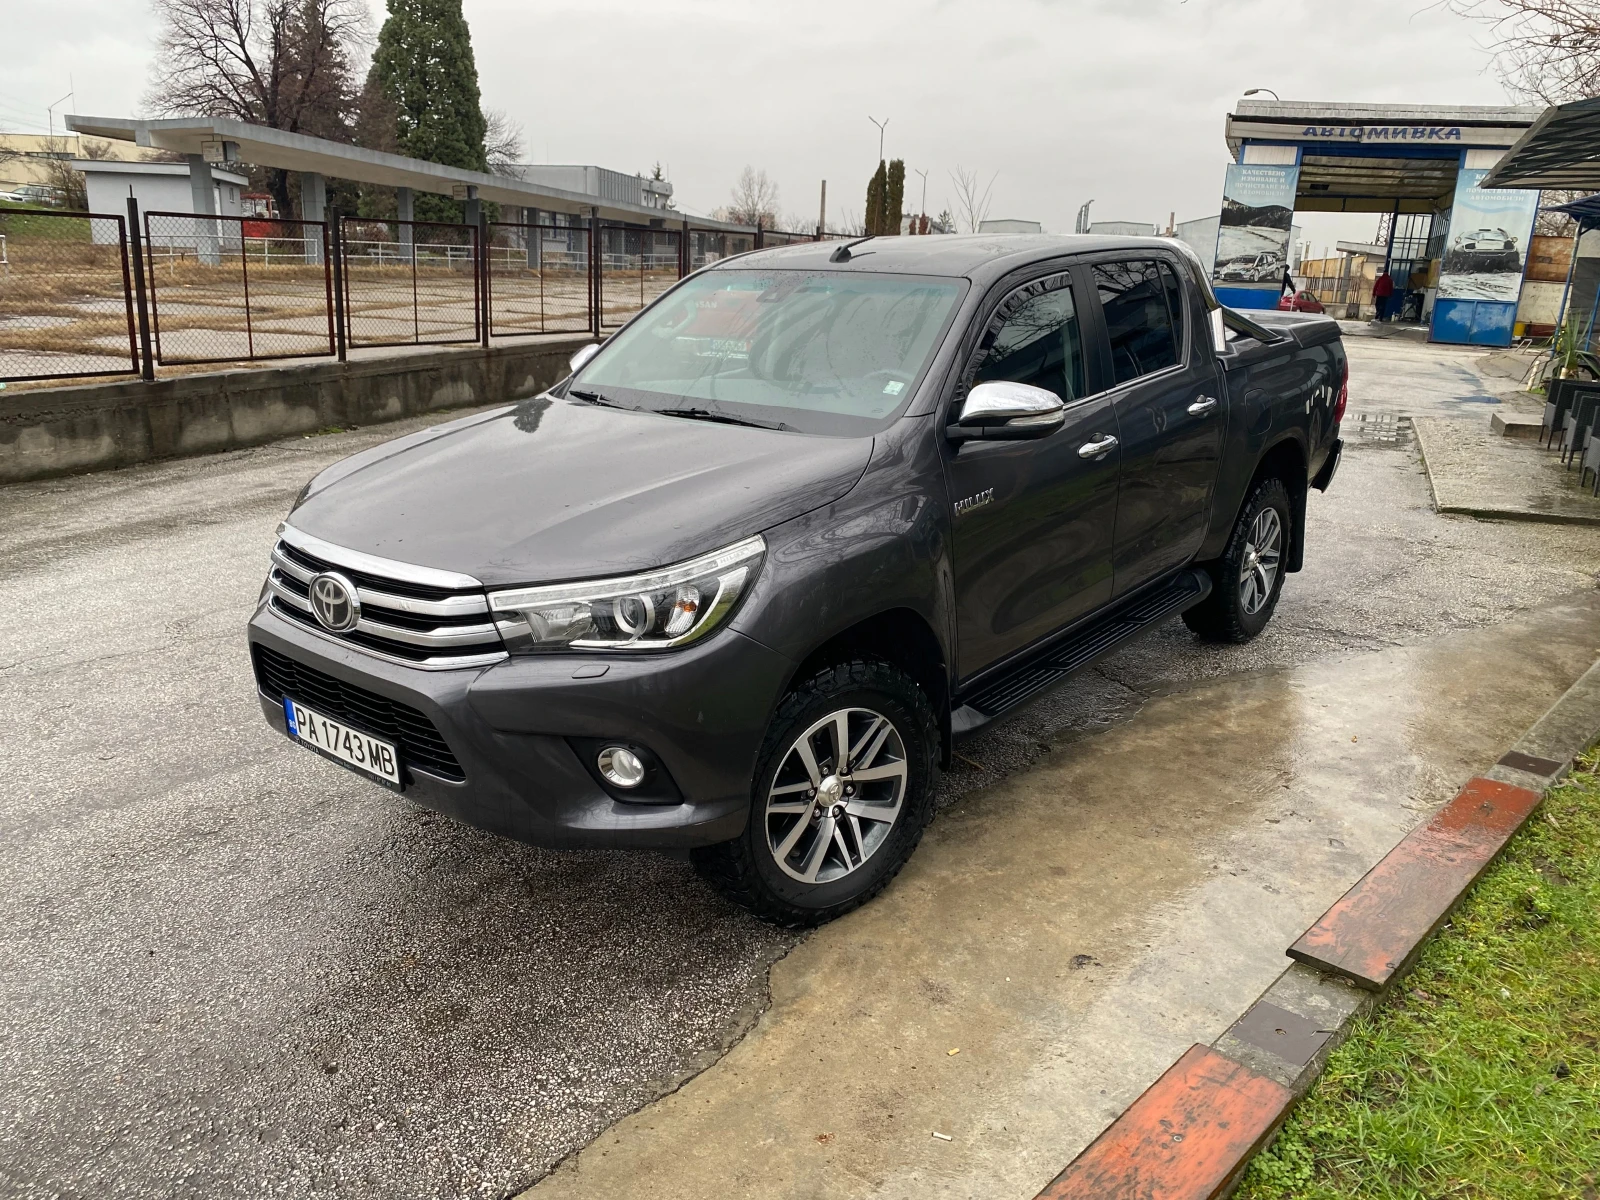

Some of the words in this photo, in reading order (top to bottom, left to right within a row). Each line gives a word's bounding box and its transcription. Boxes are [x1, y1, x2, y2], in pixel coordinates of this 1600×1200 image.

[1302, 126, 1461, 140] АВТОМИВКА
[954, 487, 994, 517] HILUX
[295, 706, 319, 743] PA
[321, 720, 365, 763] 1743
[367, 738, 394, 776] MB
[300, 739, 320, 755] TOYOTA
